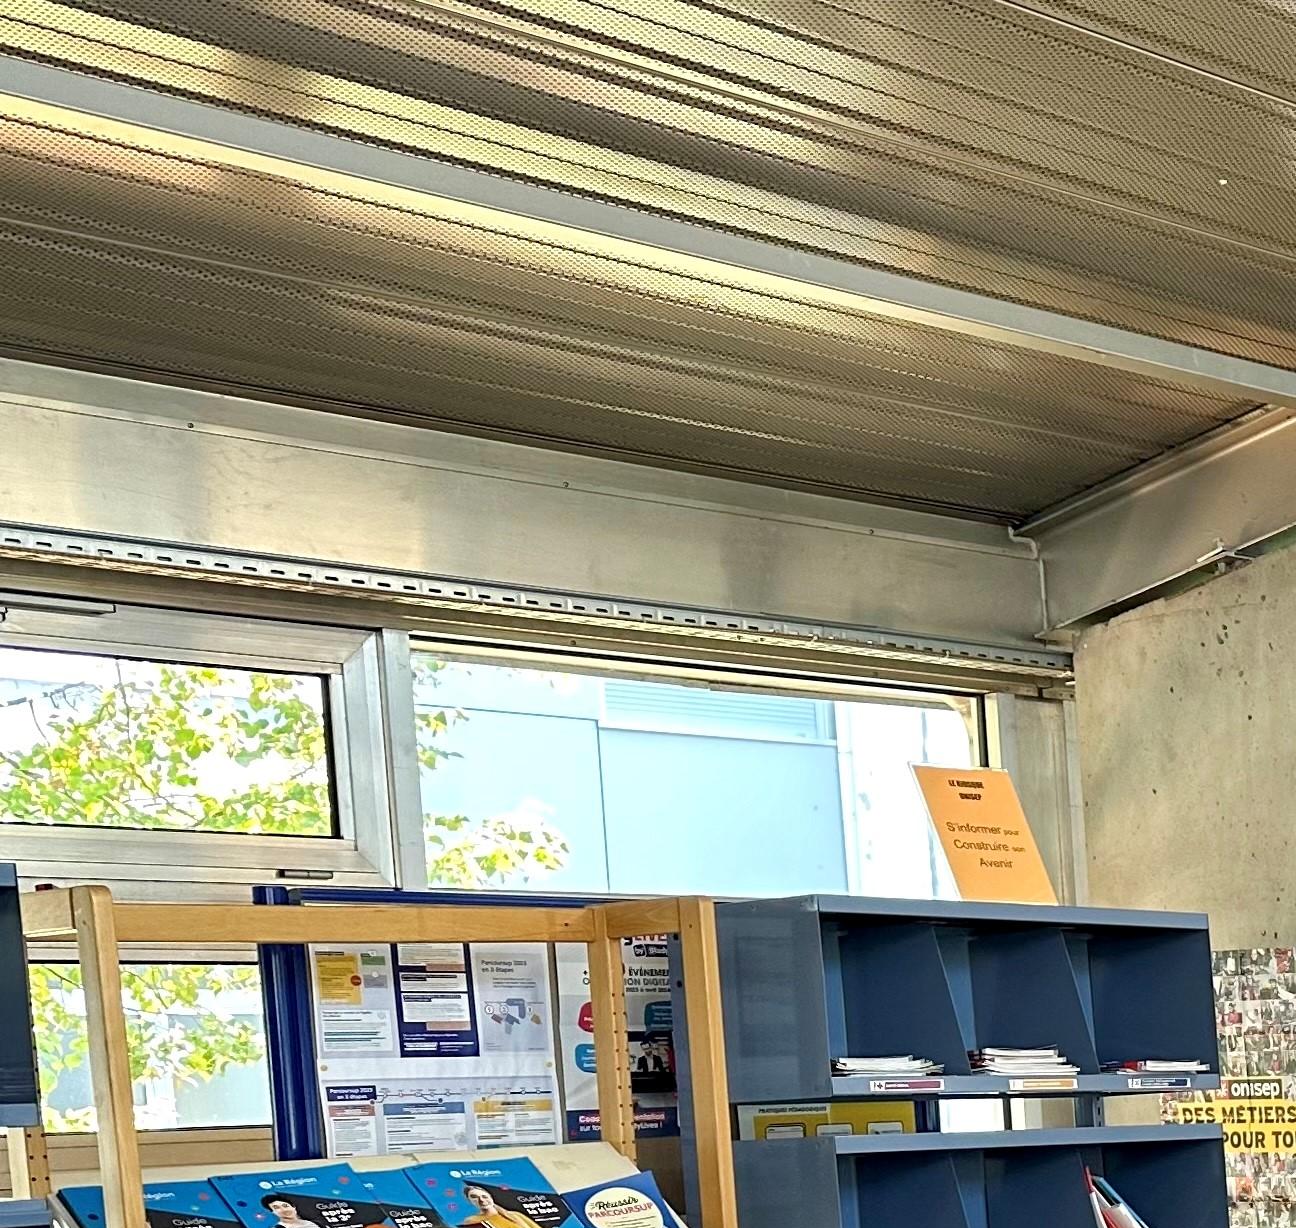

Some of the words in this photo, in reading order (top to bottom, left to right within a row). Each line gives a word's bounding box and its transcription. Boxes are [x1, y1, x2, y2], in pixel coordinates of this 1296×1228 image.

[947, 822, 1000, 835] S'informer
[954, 839, 1009, 851] Construire
[980, 858, 1013, 868] Avenir
[1231, 1081, 1281, 1099] onisep
[1182, 1106, 1214, 1124] DES
[285, 1177, 317, 1186] Région
[517, 1195, 546, 1203] Guide
[316, 1202, 348, 1210] Guide
[588, 1202, 653, 1218] PARCOURSUP
[389, 1209, 421, 1218] Guide
[172, 1218, 207, 1226] Guide
